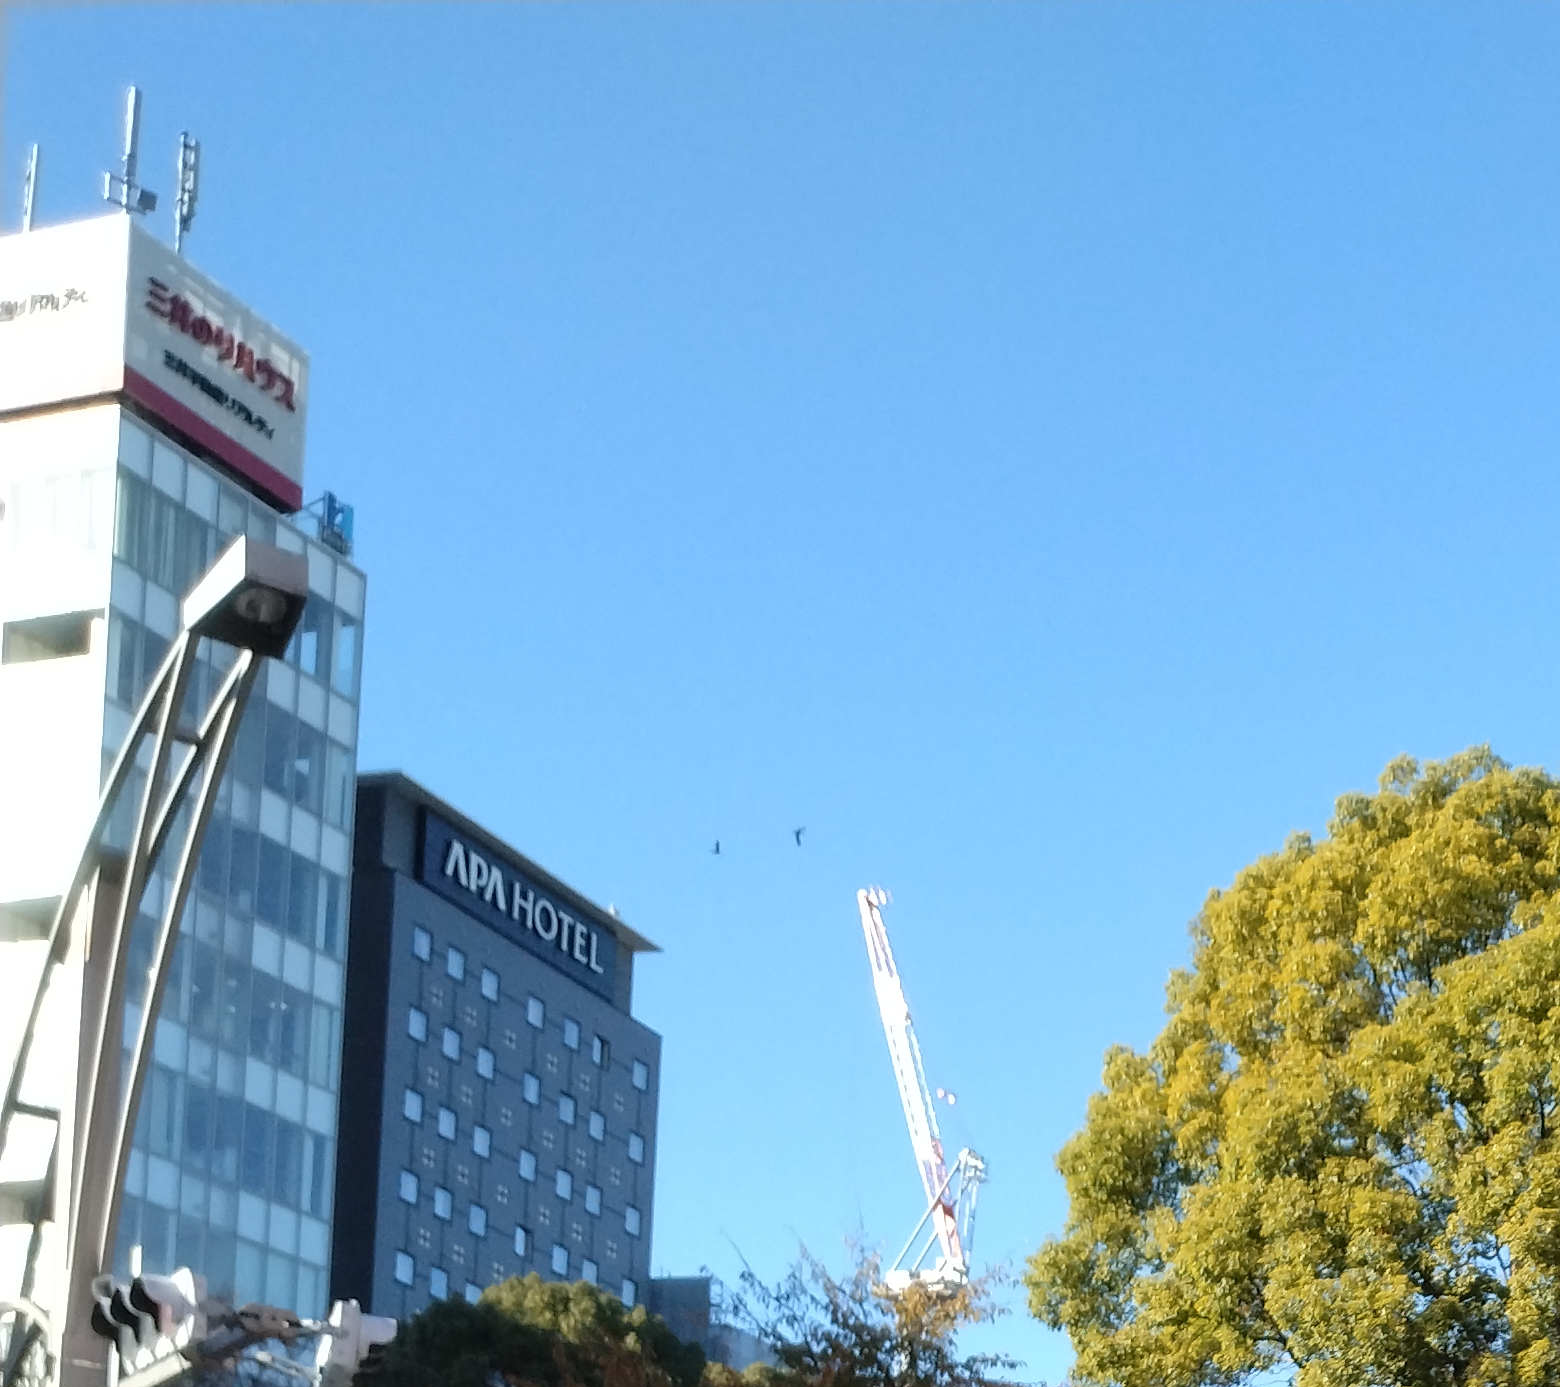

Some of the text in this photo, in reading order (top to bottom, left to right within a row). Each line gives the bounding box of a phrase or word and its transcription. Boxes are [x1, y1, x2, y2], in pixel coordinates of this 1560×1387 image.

[145, 276, 296, 413] 三井のリハウス
[445, 839, 604, 974] APA HOTEL
